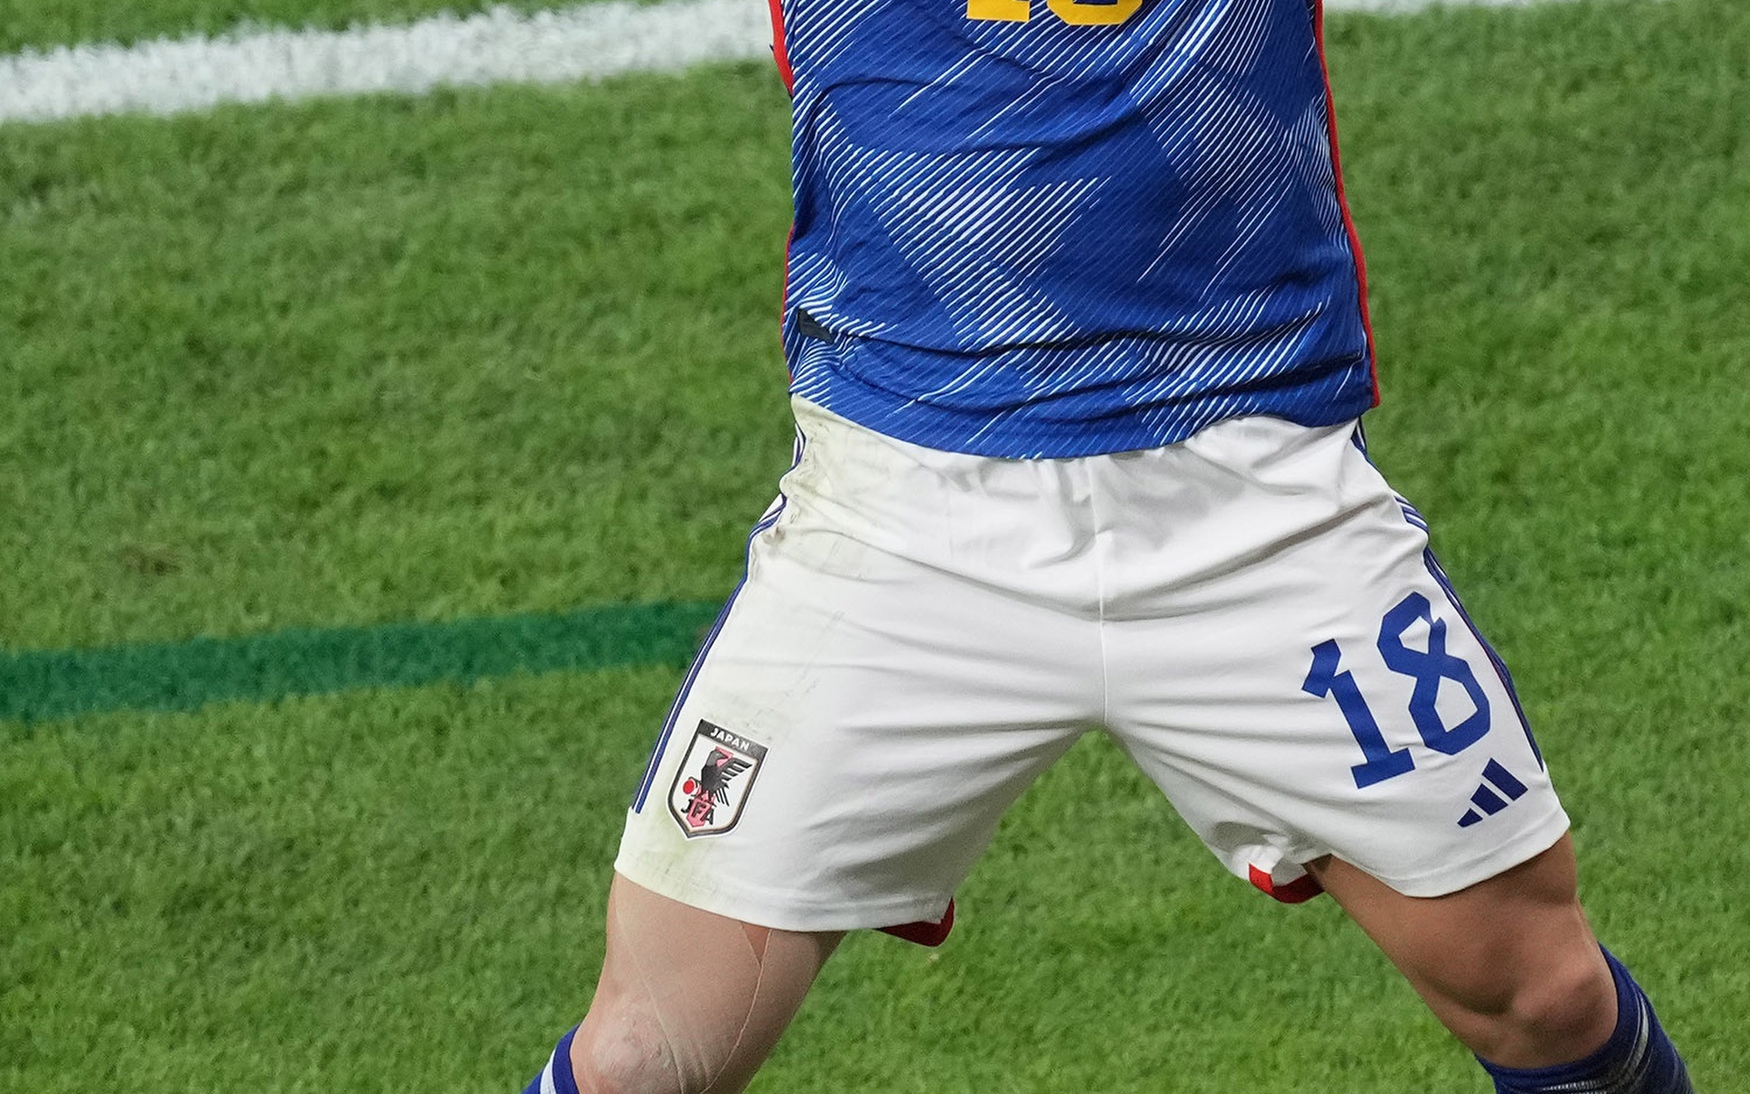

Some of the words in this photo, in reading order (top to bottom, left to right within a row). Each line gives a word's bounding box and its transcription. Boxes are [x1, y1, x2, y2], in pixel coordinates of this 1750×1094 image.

[1301, 591, 1491, 789] 18
[710, 727, 750, 751] JAPAN
[681, 799, 714, 825] JFA
